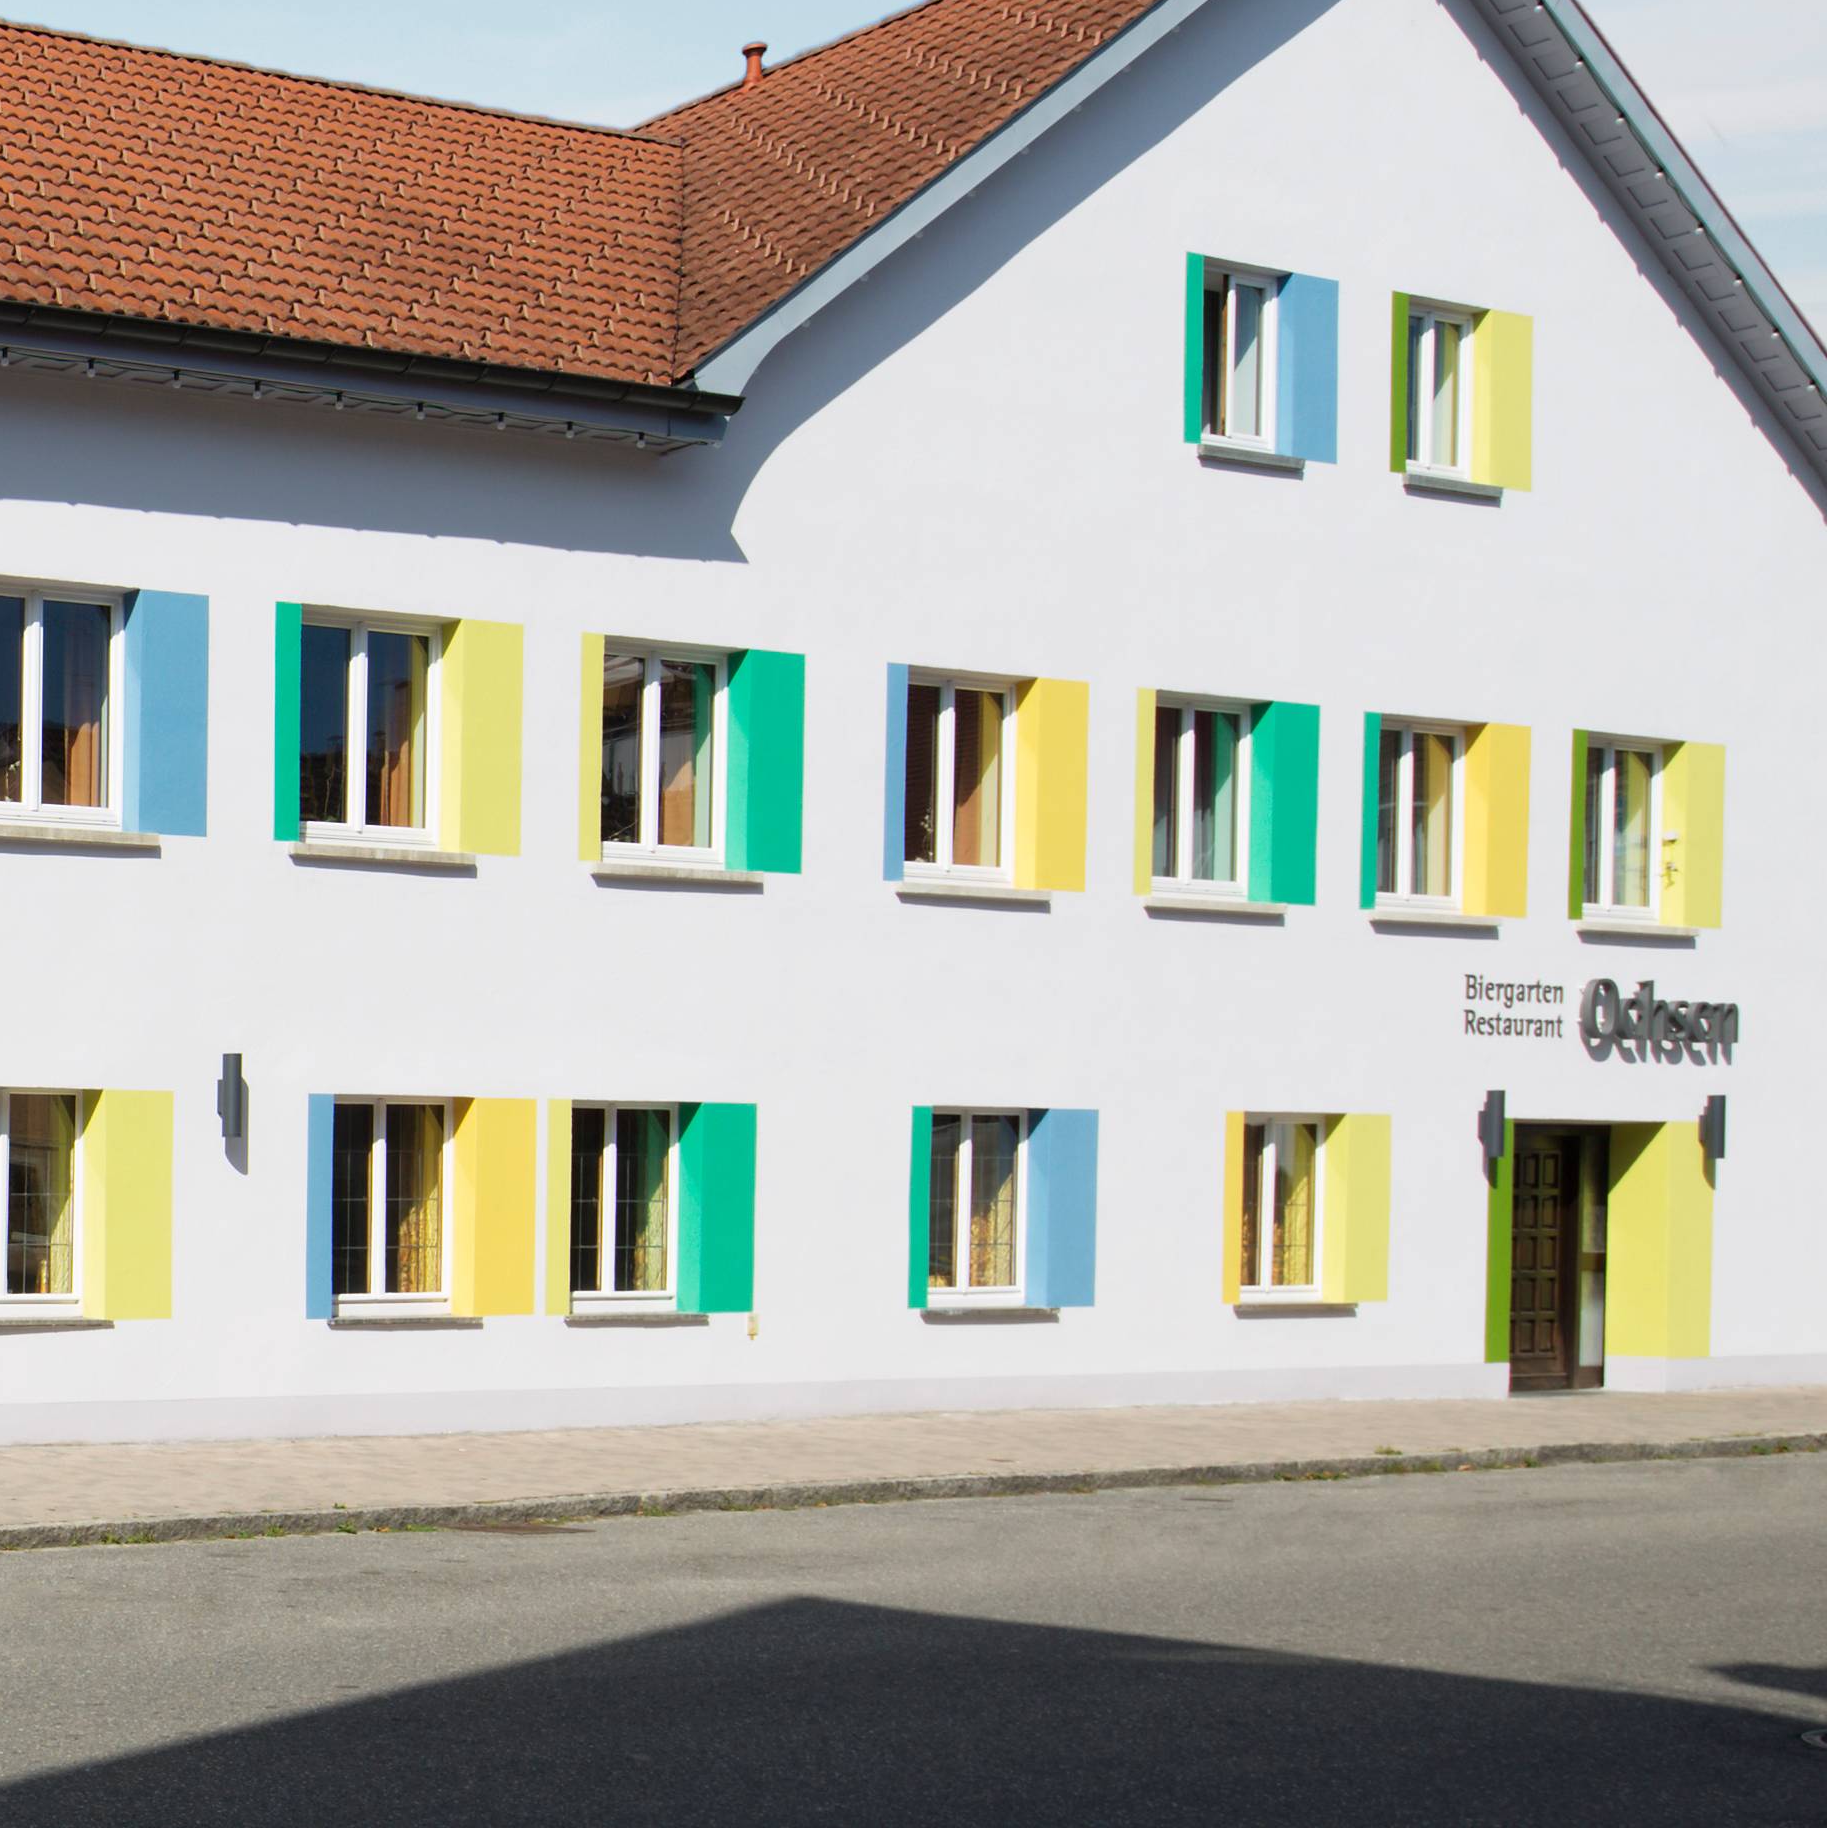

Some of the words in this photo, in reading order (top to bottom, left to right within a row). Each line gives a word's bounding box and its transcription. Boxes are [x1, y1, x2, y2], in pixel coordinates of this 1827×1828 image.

[1464, 974, 1564, 1008] Biergarten
[1464, 1010, 1563, 1038] Restaurant
[1579, 978, 1739, 1043] Ochsen
